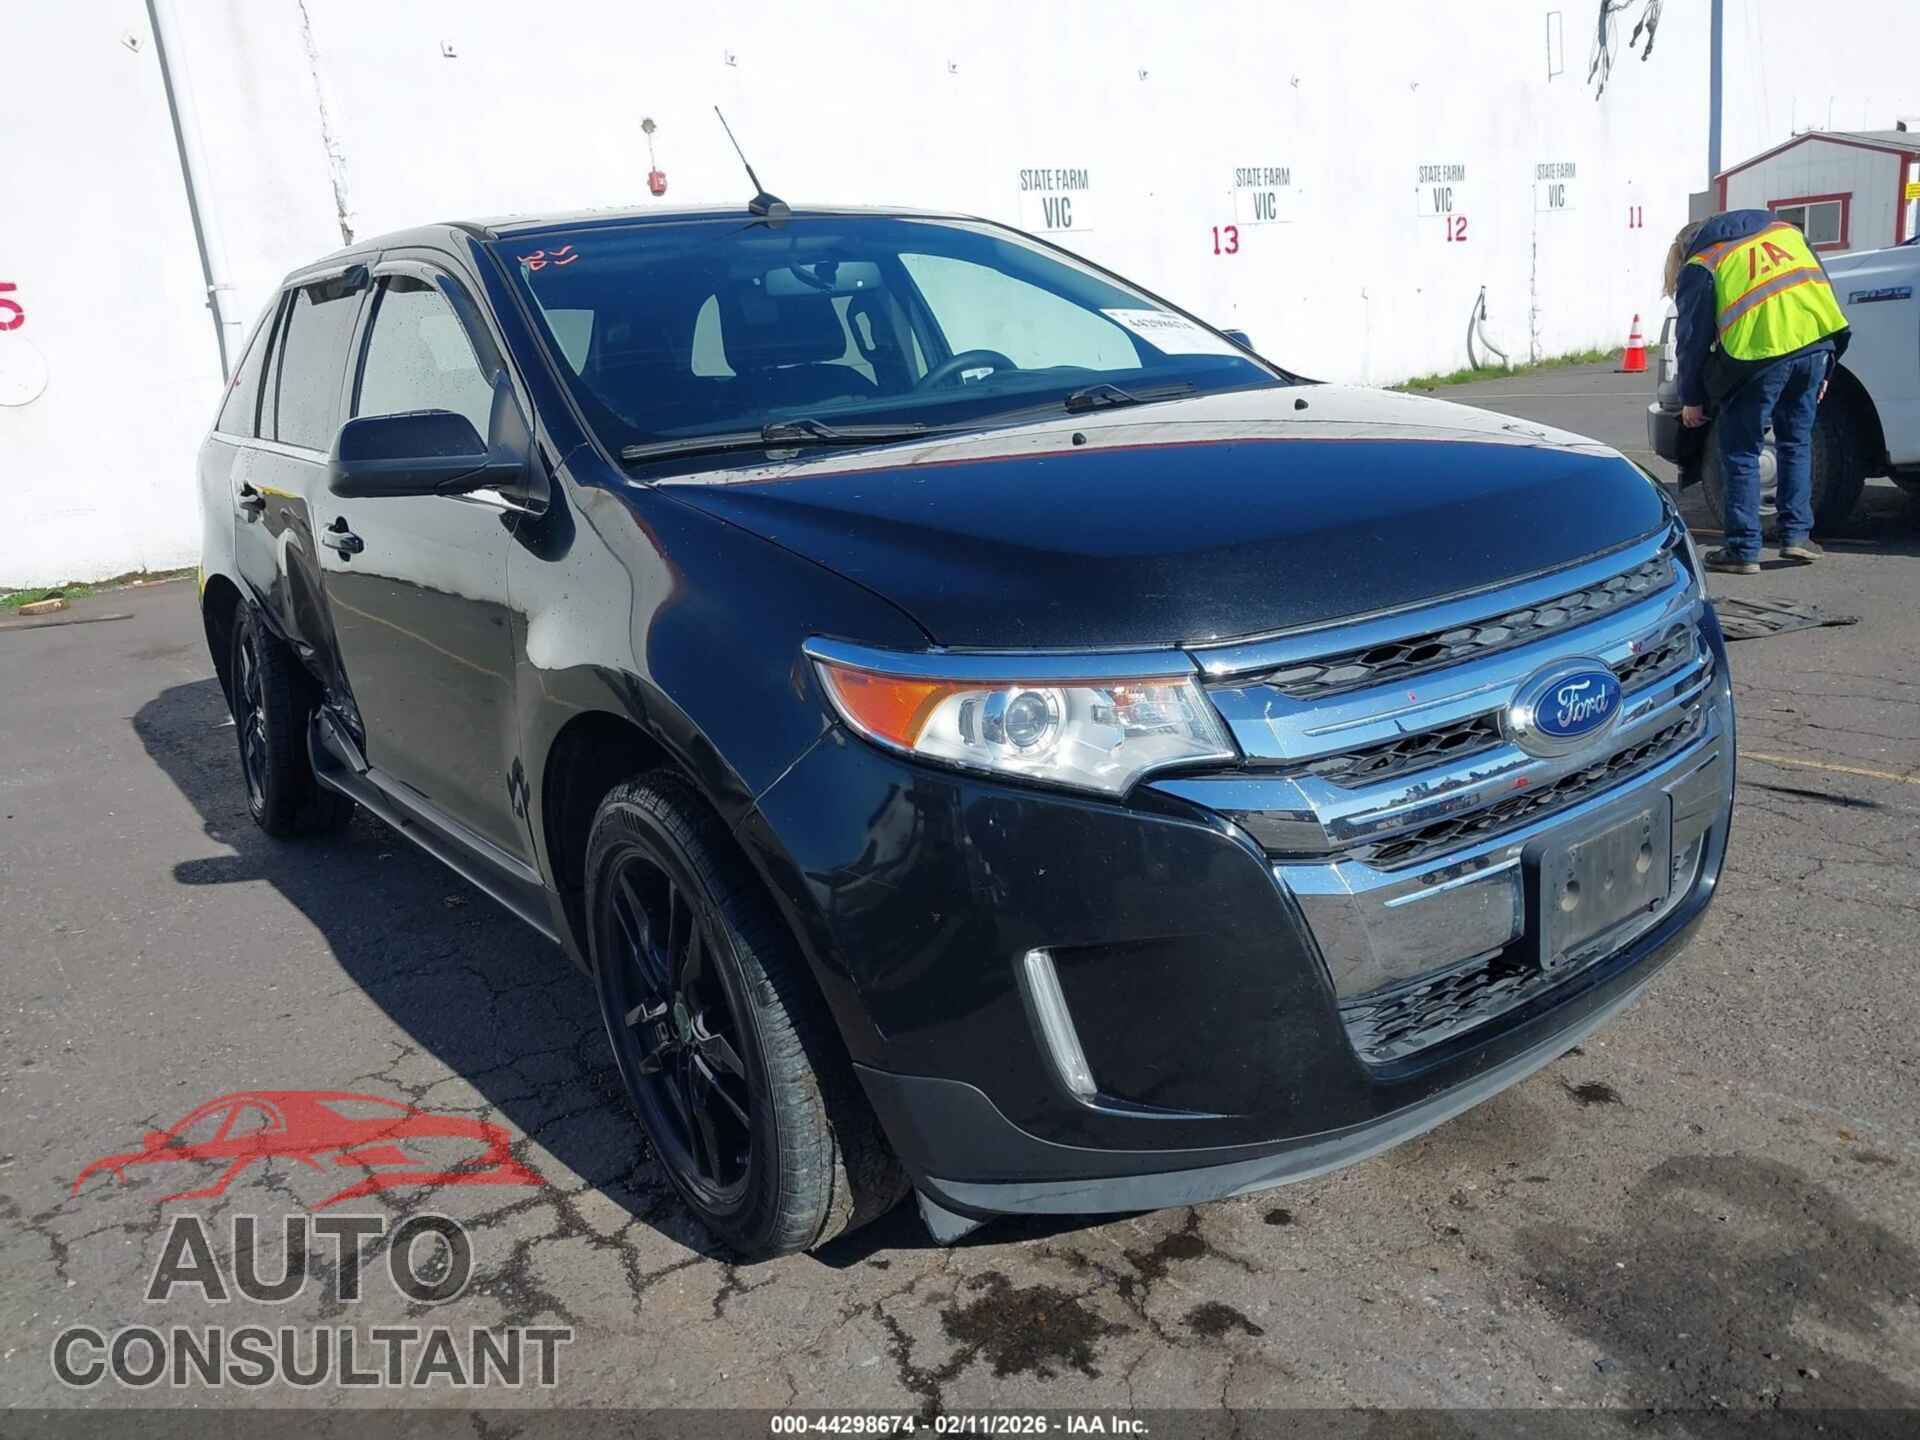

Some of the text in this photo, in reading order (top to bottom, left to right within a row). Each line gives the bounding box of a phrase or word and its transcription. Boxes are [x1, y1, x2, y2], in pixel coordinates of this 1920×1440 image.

[1020, 168, 1088, 191] STATE FARM
[1235, 167, 1290, 188] STATE FARM
[1418, 164, 1465, 183] STATE FARM
[1537, 162, 1576, 180] STATE FARM
[1253, 192, 1277, 221] VIC
[1433, 187, 1452, 213] VIC
[1548, 184, 1565, 208] VIC
[1042, 196, 1072, 228] VIC
[1629, 206, 1642, 229] 11
[1212, 225, 1240, 255] 13
[1447, 216, 1468, 242] 12
[1557, 680, 1608, 728] Ford
